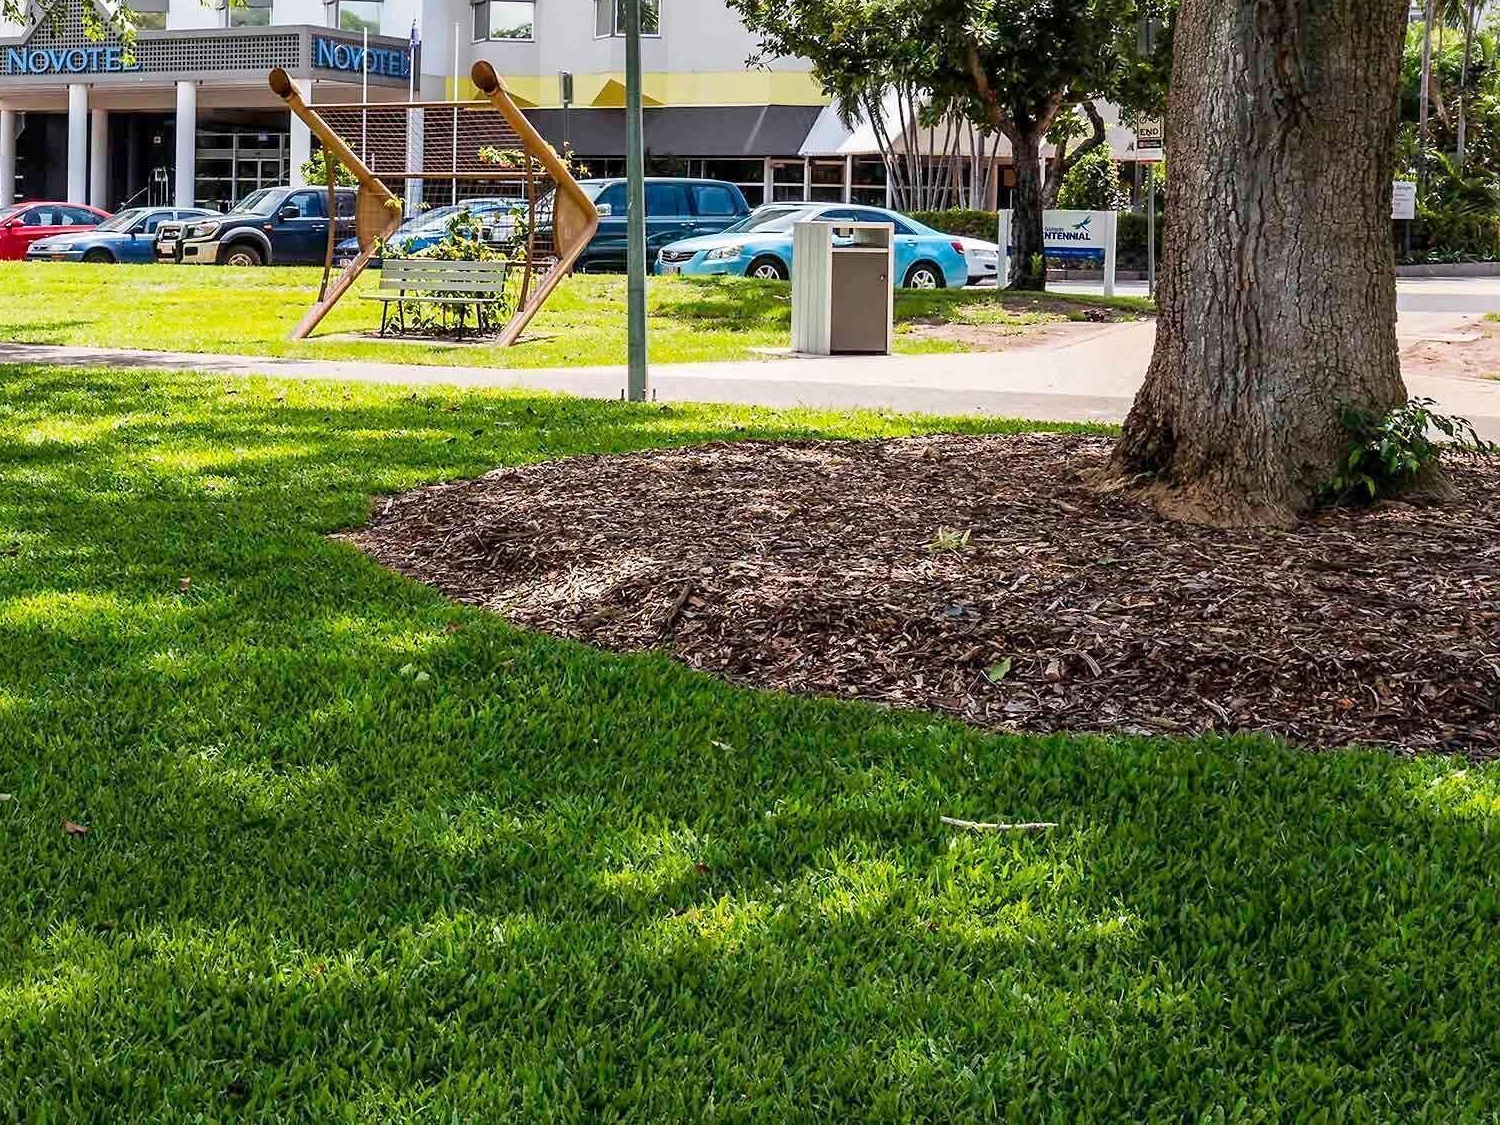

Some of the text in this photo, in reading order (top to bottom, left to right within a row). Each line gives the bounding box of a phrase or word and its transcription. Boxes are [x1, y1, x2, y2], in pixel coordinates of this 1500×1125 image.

[6, 47, 142, 74] NOVOTEL
[1140, 128, 1159, 136] END
[1044, 231, 1091, 241] NTENNIAL
